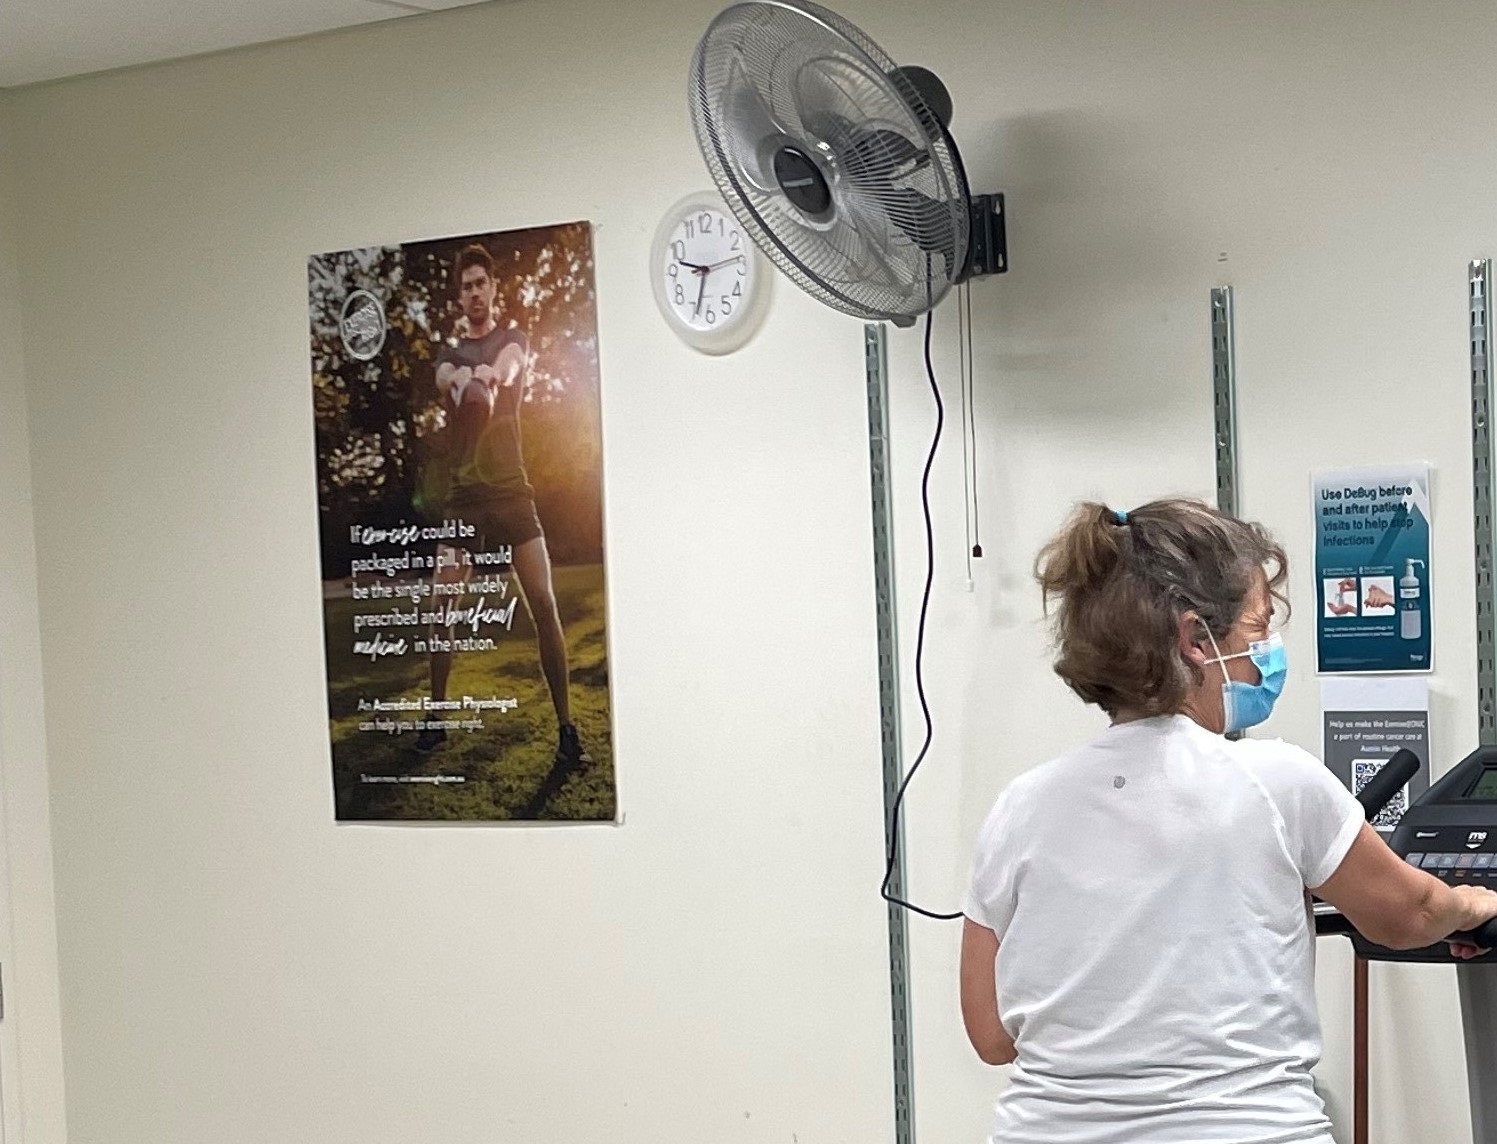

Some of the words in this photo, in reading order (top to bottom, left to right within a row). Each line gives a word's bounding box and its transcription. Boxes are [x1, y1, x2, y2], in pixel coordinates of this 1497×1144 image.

[684, 220, 694, 239] 11
[699, 212, 712, 233] 12
[718, 218, 724, 237] 1
[671, 240, 686, 261] 10
[730, 230, 740, 251] 2
[668, 264, 678, 282] 9
[737, 255, 746, 276] 3
[675, 284, 684, 305] 8
[732, 280, 741, 296] 4
[689, 301, 697, 320] 7
[706, 304, 716, 324] 6
[721, 295, 732, 315] 5
[1322, 488, 1342, 500] Use
[1344, 486, 1377, 501] DeBug
[1378, 484, 1413, 497] before
[1323, 503, 1343, 515] and
[1345, 502, 1369, 515] after
[1371, 500, 1408, 516] patient
[350, 524, 361, 544] If
[422, 519, 456, 540] could
[459, 518, 476, 538] be
[1323, 519, 1350, 531] visits
[1353, 519, 1363, 530] to
[1364, 517, 1388, 532] help
[1390, 517, 1413, 532] stop
[352, 551, 409, 577] packaged
[412, 550, 426, 569] in
[427, 554, 435, 568] a
[437, 547, 459, 574] pill,
[462, 547, 472, 566] it
[474, 544, 512, 566] would
[352, 581, 369, 600] be
[371, 580, 393, 599] the
[395, 578, 430, 604] single
[434, 579, 466, 597] most
[468, 575, 508, 600] widely
[354, 607, 418, 633] prescribed
[420, 605, 444, 625] and
[414, 634, 427, 653] in
[429, 633, 451, 653] the
[454, 634, 498, 652] nation.
[358, 698, 372, 711] An
[374, 697, 421, 711] Accredited
[423, 696, 461, 710] Exercise
[463, 695, 518, 714] Physiologist
[376, 716, 395, 735] help
[396, 721, 414, 735] you
[1329, 720, 1344, 729] Help
[1354, 720, 1372, 728] make
[1373, 720, 1383, 728] the
